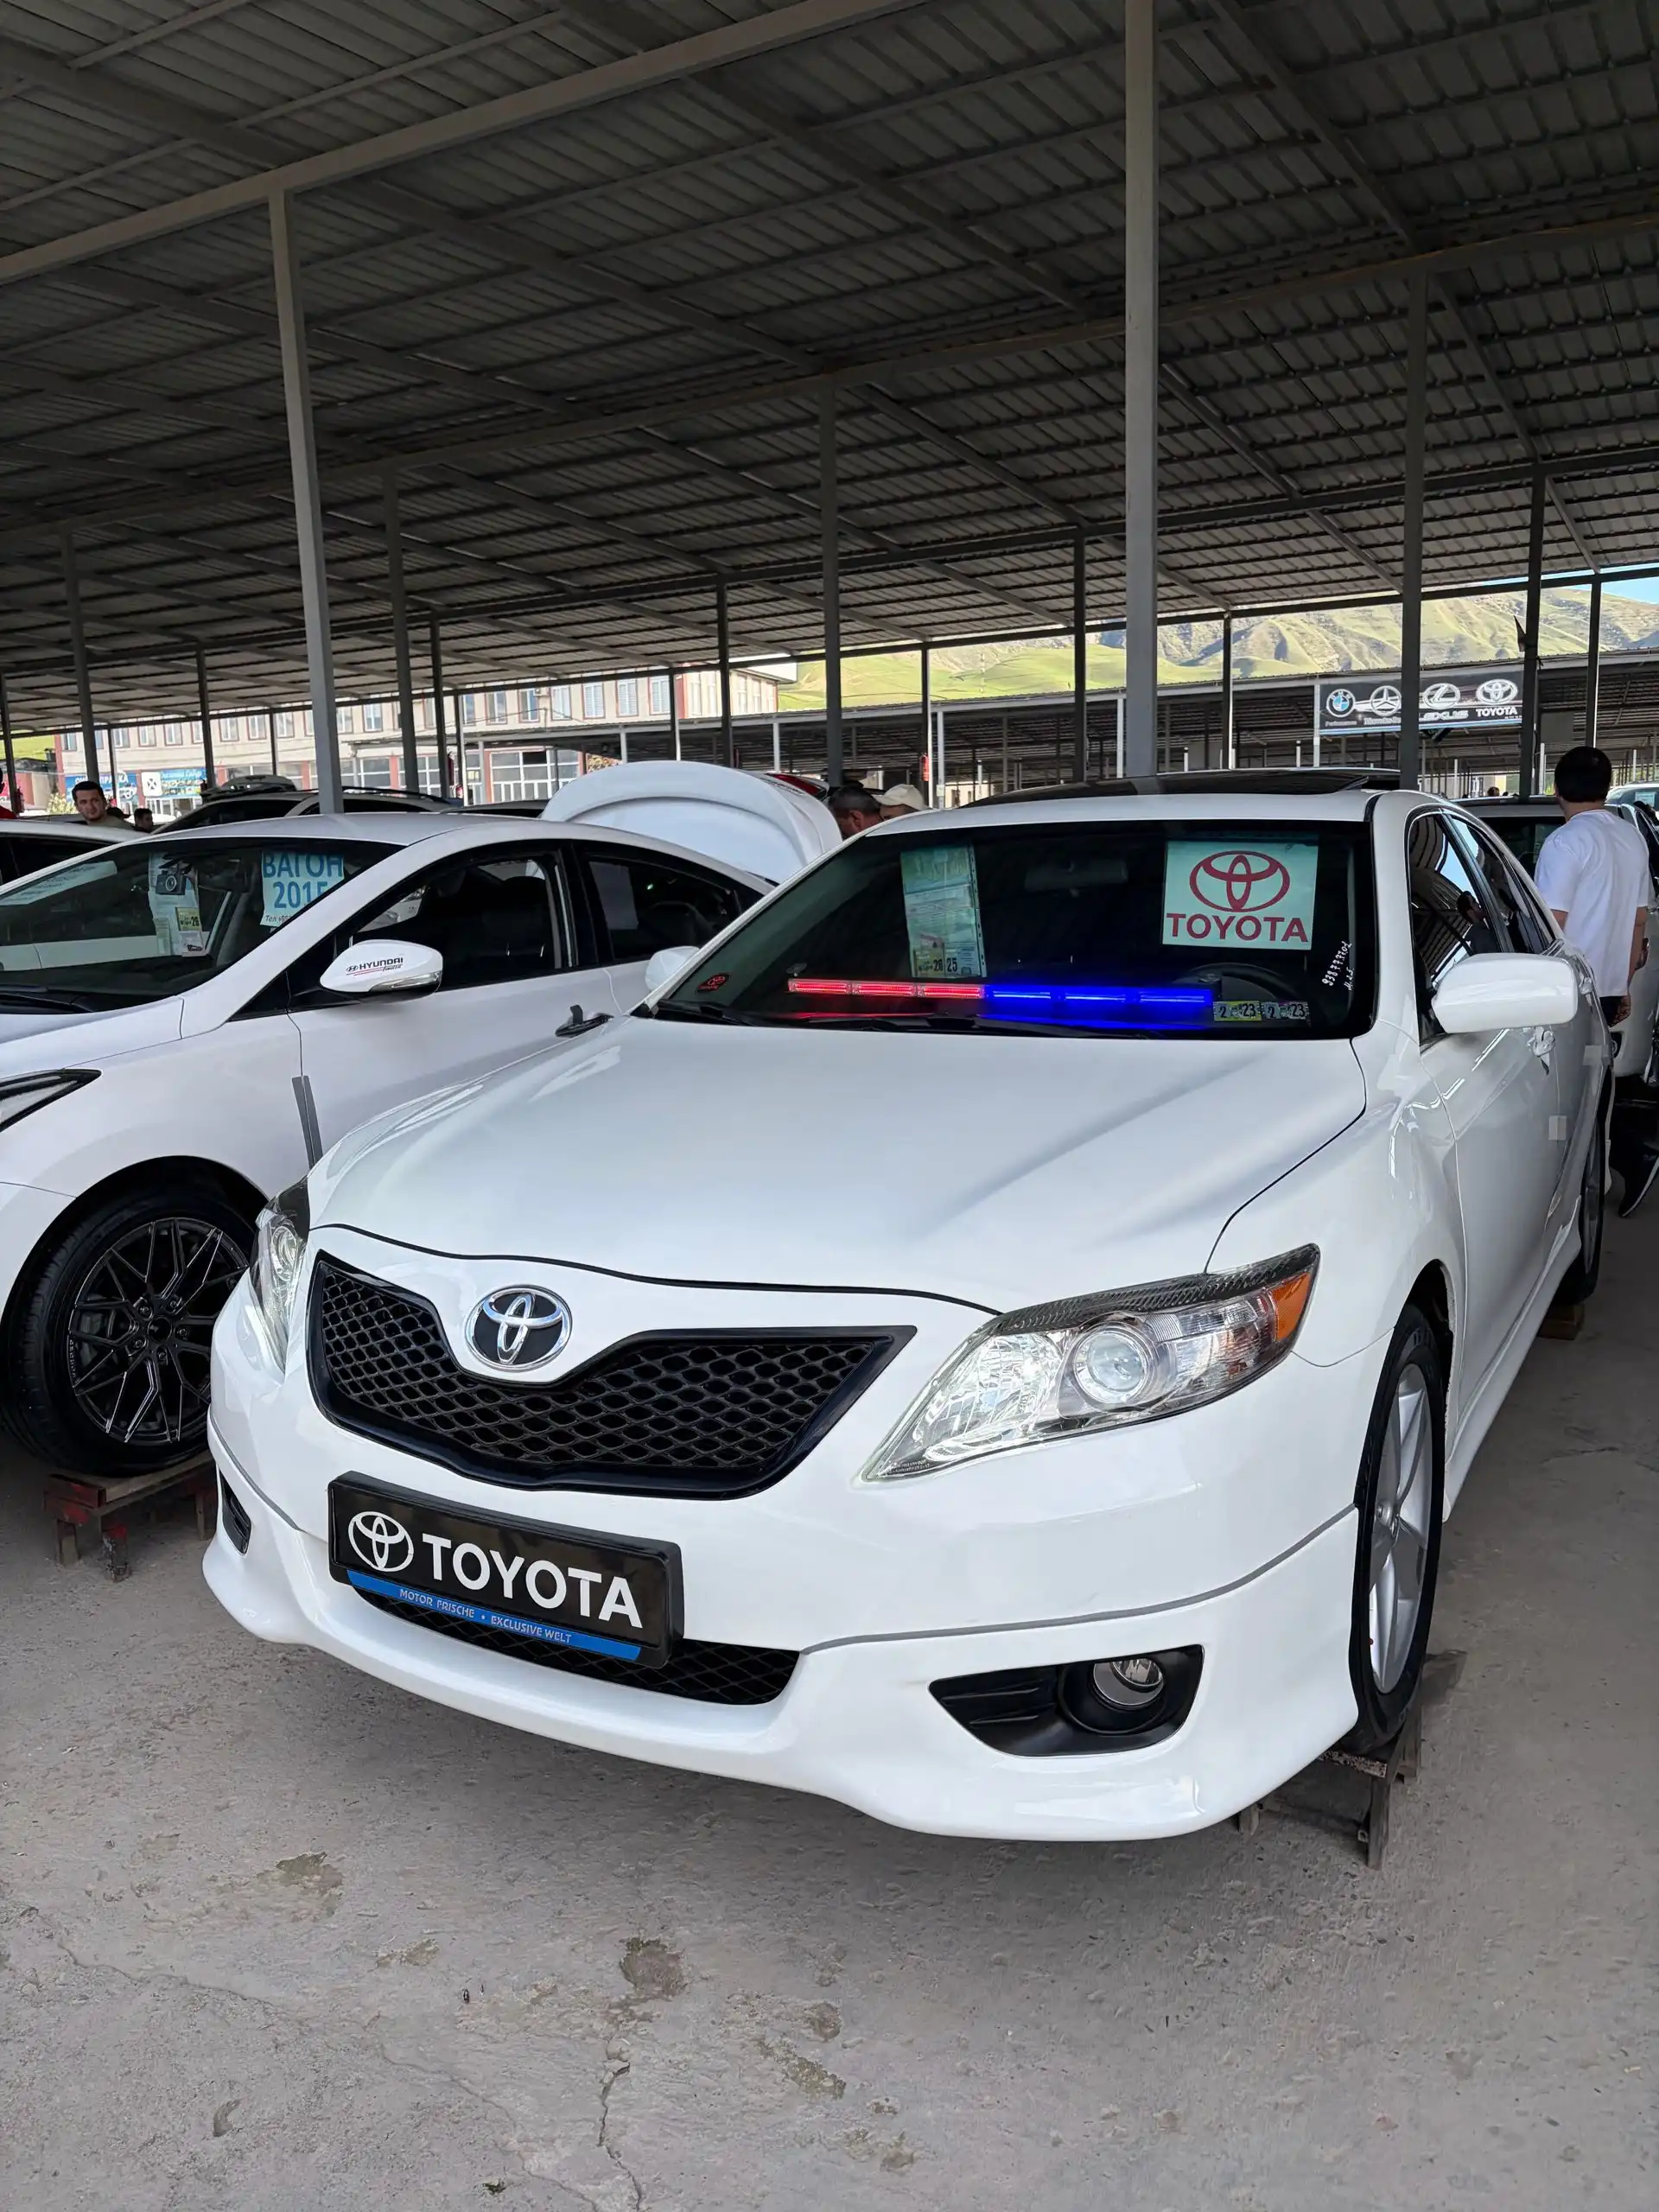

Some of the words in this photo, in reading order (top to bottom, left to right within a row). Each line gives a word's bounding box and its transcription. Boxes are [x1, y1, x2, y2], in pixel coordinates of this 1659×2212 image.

[1476, 706, 1518, 717] TOYOTA
[1166, 912, 1309, 943] TOYOTA
[359, 957, 404, 970] HYUNDAI
[422, 1533, 644, 1629] TOYOTA
[399, 1588, 433, 1607] MOTOR
[436, 1599, 474, 1618] FRISCHE
[491, 1615, 543, 1637] EXCLUSIVE
[544, 1628, 572, 1643] WELT
